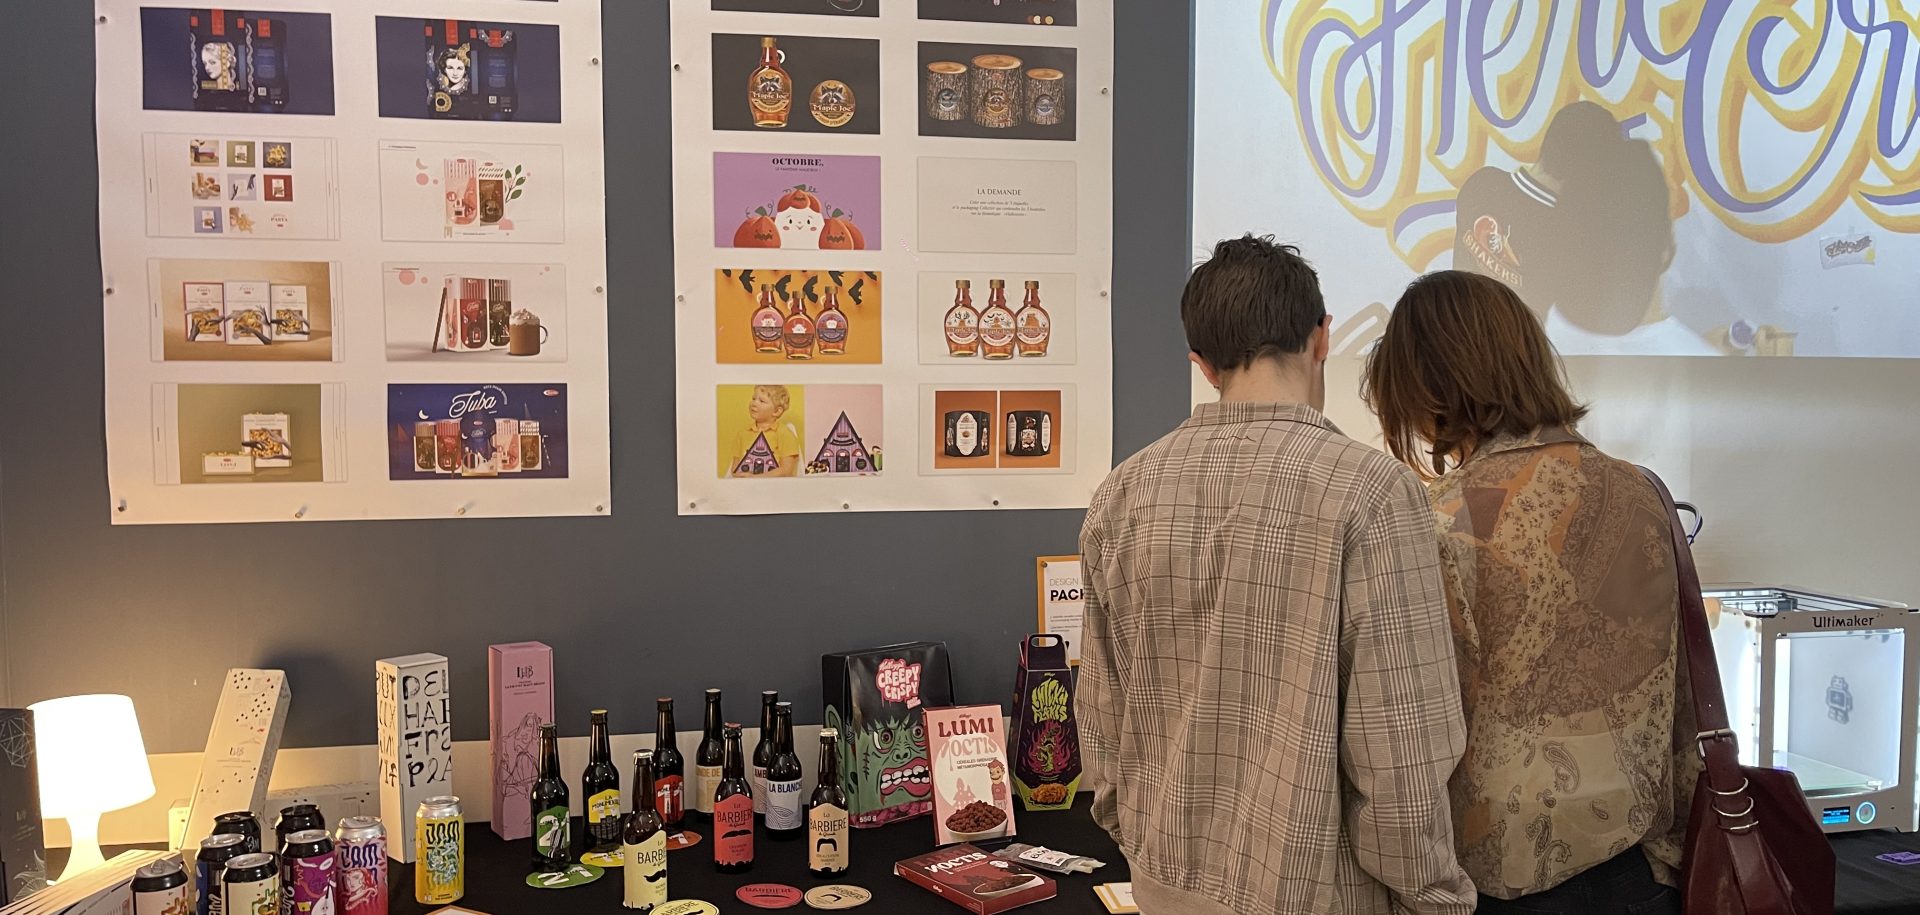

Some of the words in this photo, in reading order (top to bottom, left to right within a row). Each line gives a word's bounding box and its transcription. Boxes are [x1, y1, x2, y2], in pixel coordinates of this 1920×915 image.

[987, 188, 1022, 196] DEMANDE
[1465, 233, 1518, 285] SHAKERS
[1050, 577, 1079, 586] DESIGN
[1812, 614, 1875, 628] Ultimaker
[878, 665, 919, 688] CREEPY
[884, 681, 918, 700] CRISPY
[938, 717, 994, 738] LUMI
[768, 783, 776, 793] LA
[859, 815, 871, 823] 550
[426, 820, 459, 845] JAM
[340, 843, 378, 868] JAM
[924, 852, 988, 875] NOCTIS
